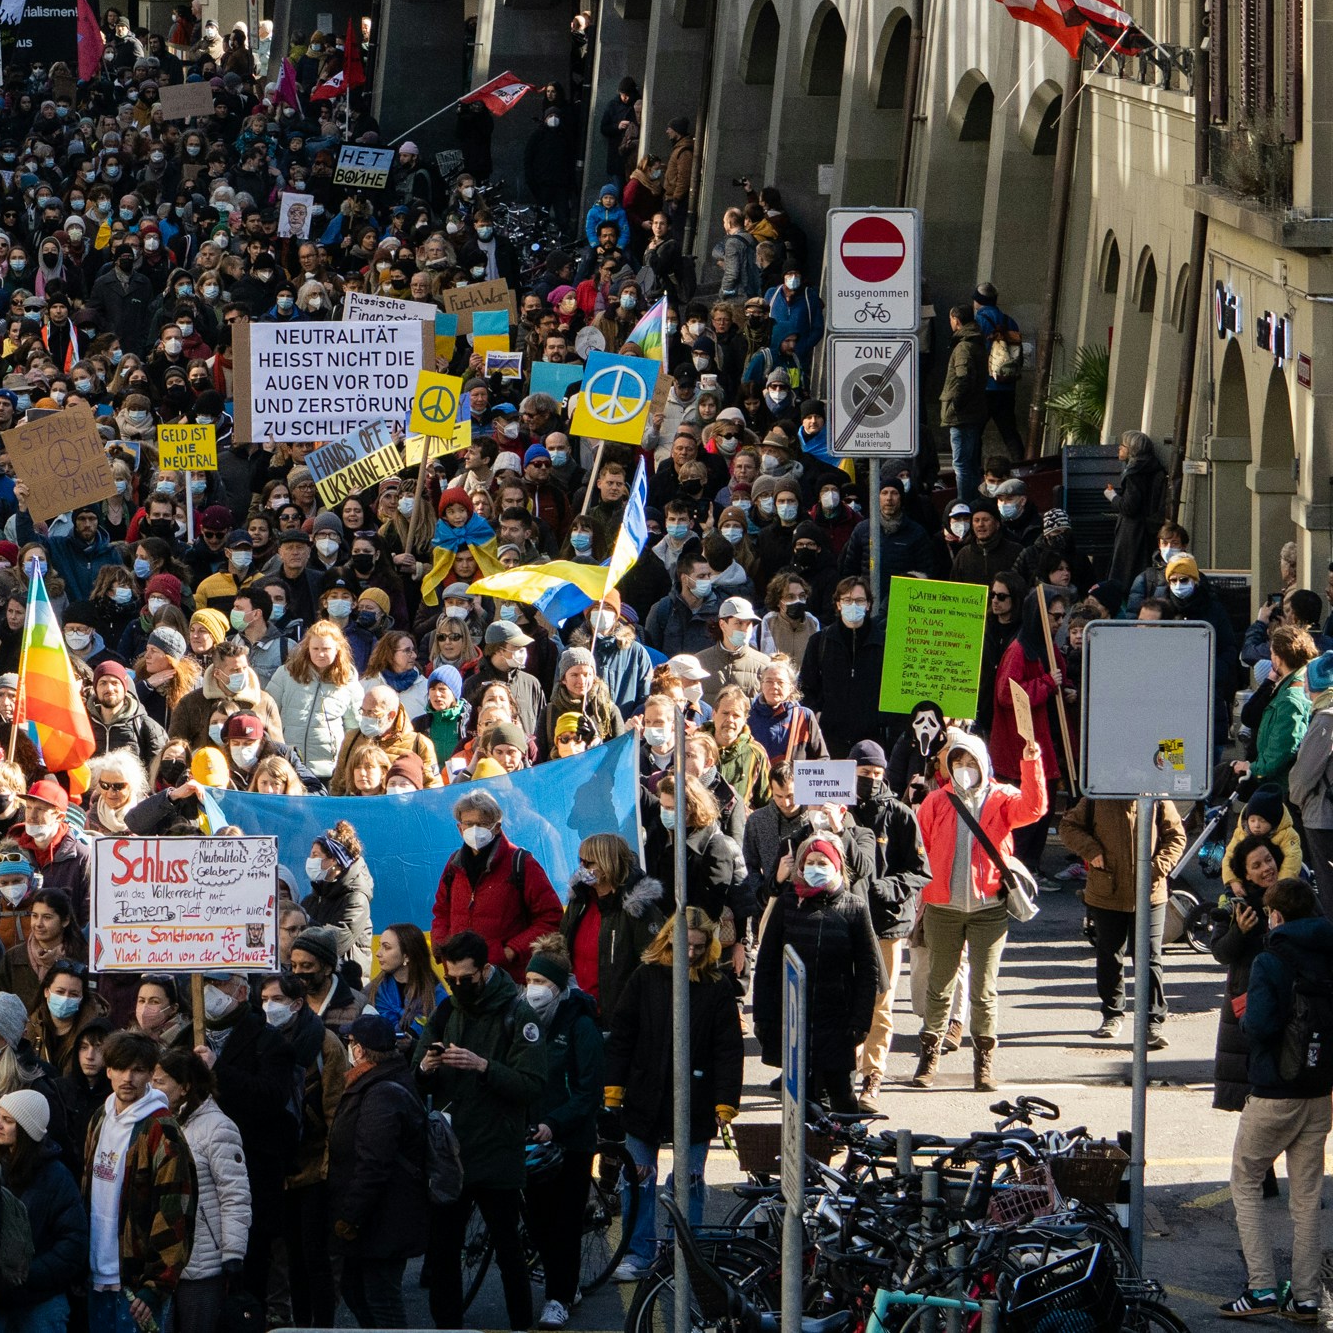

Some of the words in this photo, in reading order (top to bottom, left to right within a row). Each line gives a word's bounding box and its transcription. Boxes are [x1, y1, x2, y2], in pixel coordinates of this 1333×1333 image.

[341, 149, 385, 166] НЕТ
[350, 293, 406, 311] Russische
[449, 293, 479, 312] Fuck
[837, 289, 909, 300] ausgenommen
[275, 324, 398, 344] NEUTRALITÄT
[258, 352, 322, 368] HEISST
[326, 351, 383, 367] NICHT
[386, 351, 415, 366] DIE
[855, 346, 892, 359] ZONE
[265, 374, 331, 391] AUGEN
[334, 374, 370, 390] VOR
[373, 374, 409, 390] TOD
[254, 397, 291, 414] UND
[18, 414, 86, 450] STAND
[161, 429, 188, 442] GELD
[191, 427, 208, 441] IST
[263, 421, 289, 437] ZU
[855, 431, 890, 439] ausserhalb
[176, 443, 196, 454] NIE
[312, 436, 356, 479] HANDS
[359, 419, 383, 456] OFF
[854, 439, 891, 449] Markierung
[163, 453, 216, 468] NEUTRAL
[319, 447, 404, 506] UKRAINE!!!
[809, 779, 823, 787] STOP
[823, 779, 840, 787] PUTIN
[815, 790, 828, 798] FREE
[828, 790, 851, 798] UKRAINE
[199, 839, 214, 849] mit
[217, 839, 232, 849] dem
[111, 838, 190, 886] Schluss
[197, 864, 233, 878] Gelaber
[131, 888, 146, 899] das
[151, 883, 206, 901] Völkerrecht
[175, 901, 201, 918] platt
[205, 902, 242, 920] gemacht
[112, 925, 141, 944] harte
[147, 925, 214, 944] Sanktionen
[114, 946, 142, 963] Vladi
[147, 946, 174, 963] auch
[178, 947, 196, 963] von
[199, 946, 219, 963] der
[221, 944, 275, 965] Schweiz!
